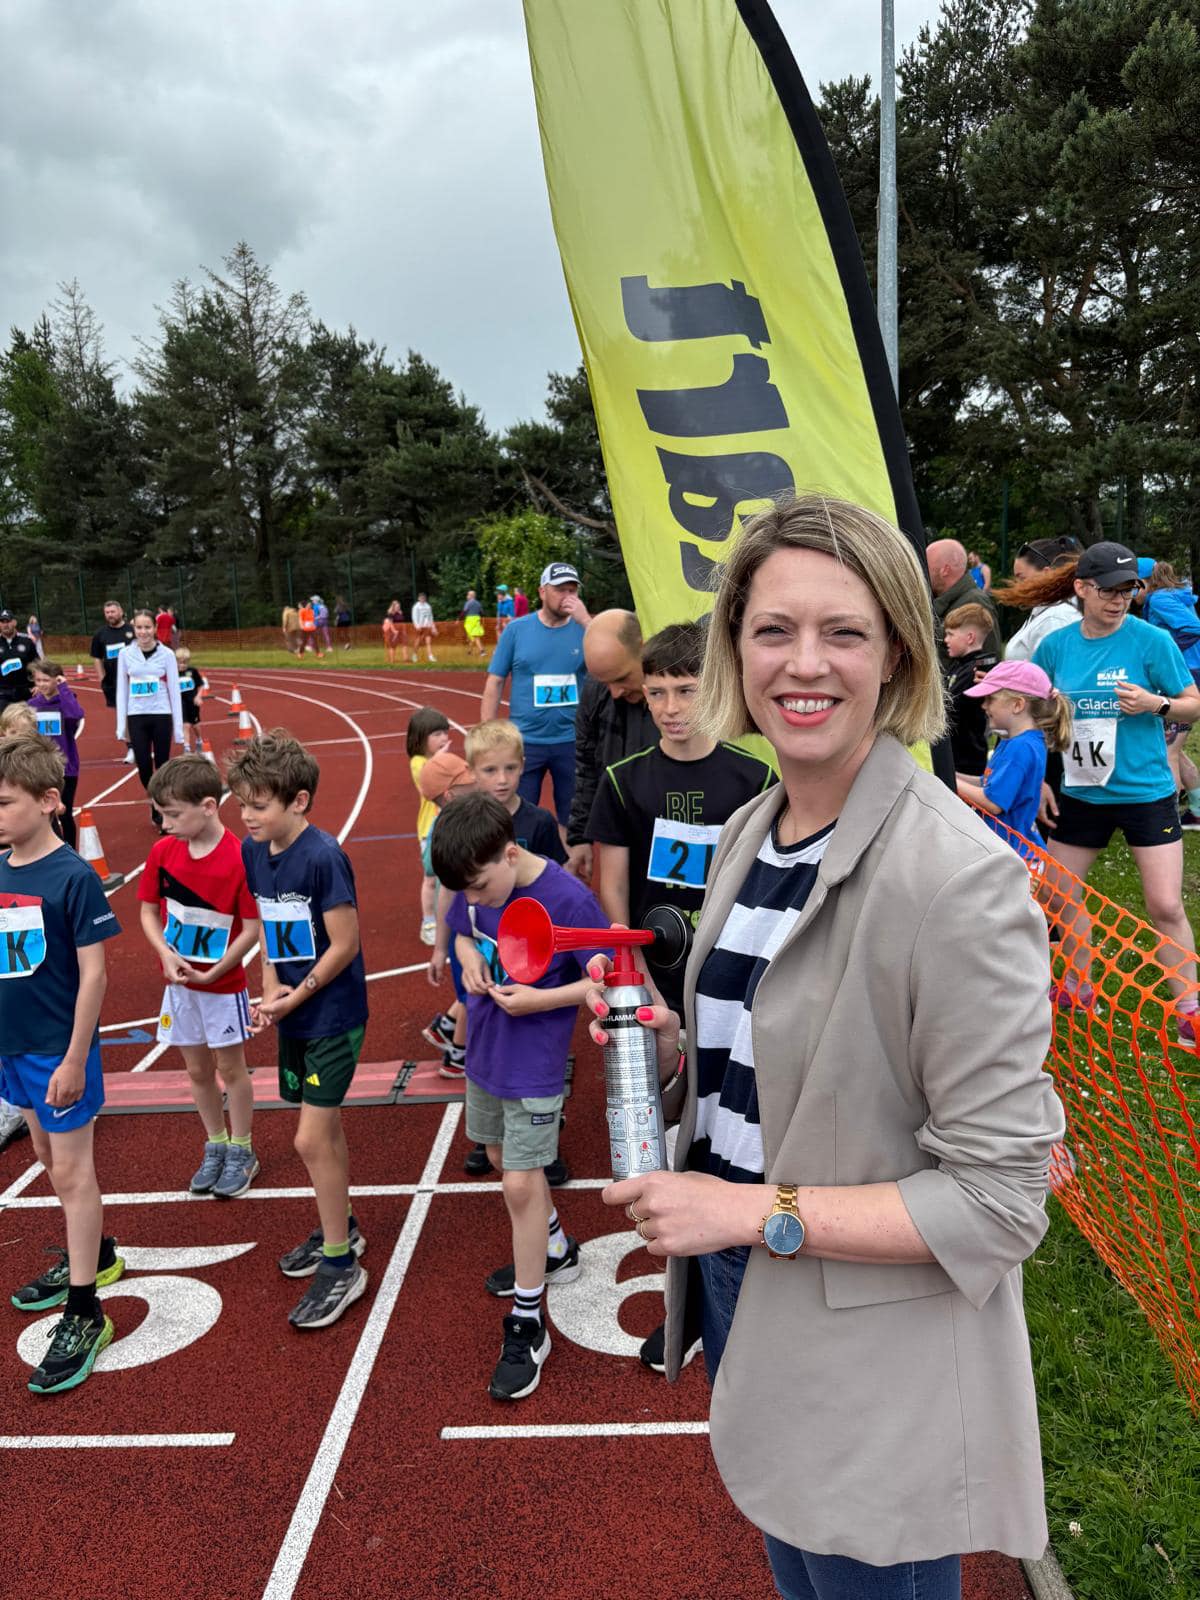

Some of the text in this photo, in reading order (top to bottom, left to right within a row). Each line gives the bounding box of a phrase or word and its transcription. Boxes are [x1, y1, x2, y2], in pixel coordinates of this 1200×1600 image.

[544, 686, 569, 704] 2 K
[1077, 698, 1120, 711] Glacie
[45, 720, 53, 733] K
[1072, 741, 1107, 767] 4 K
[666, 791, 704, 826] BE
[667, 840, 690, 881] 2
[7, 930, 31, 972] K
[173, 919, 216, 957] 2 K
[276, 921, 300, 957] K
